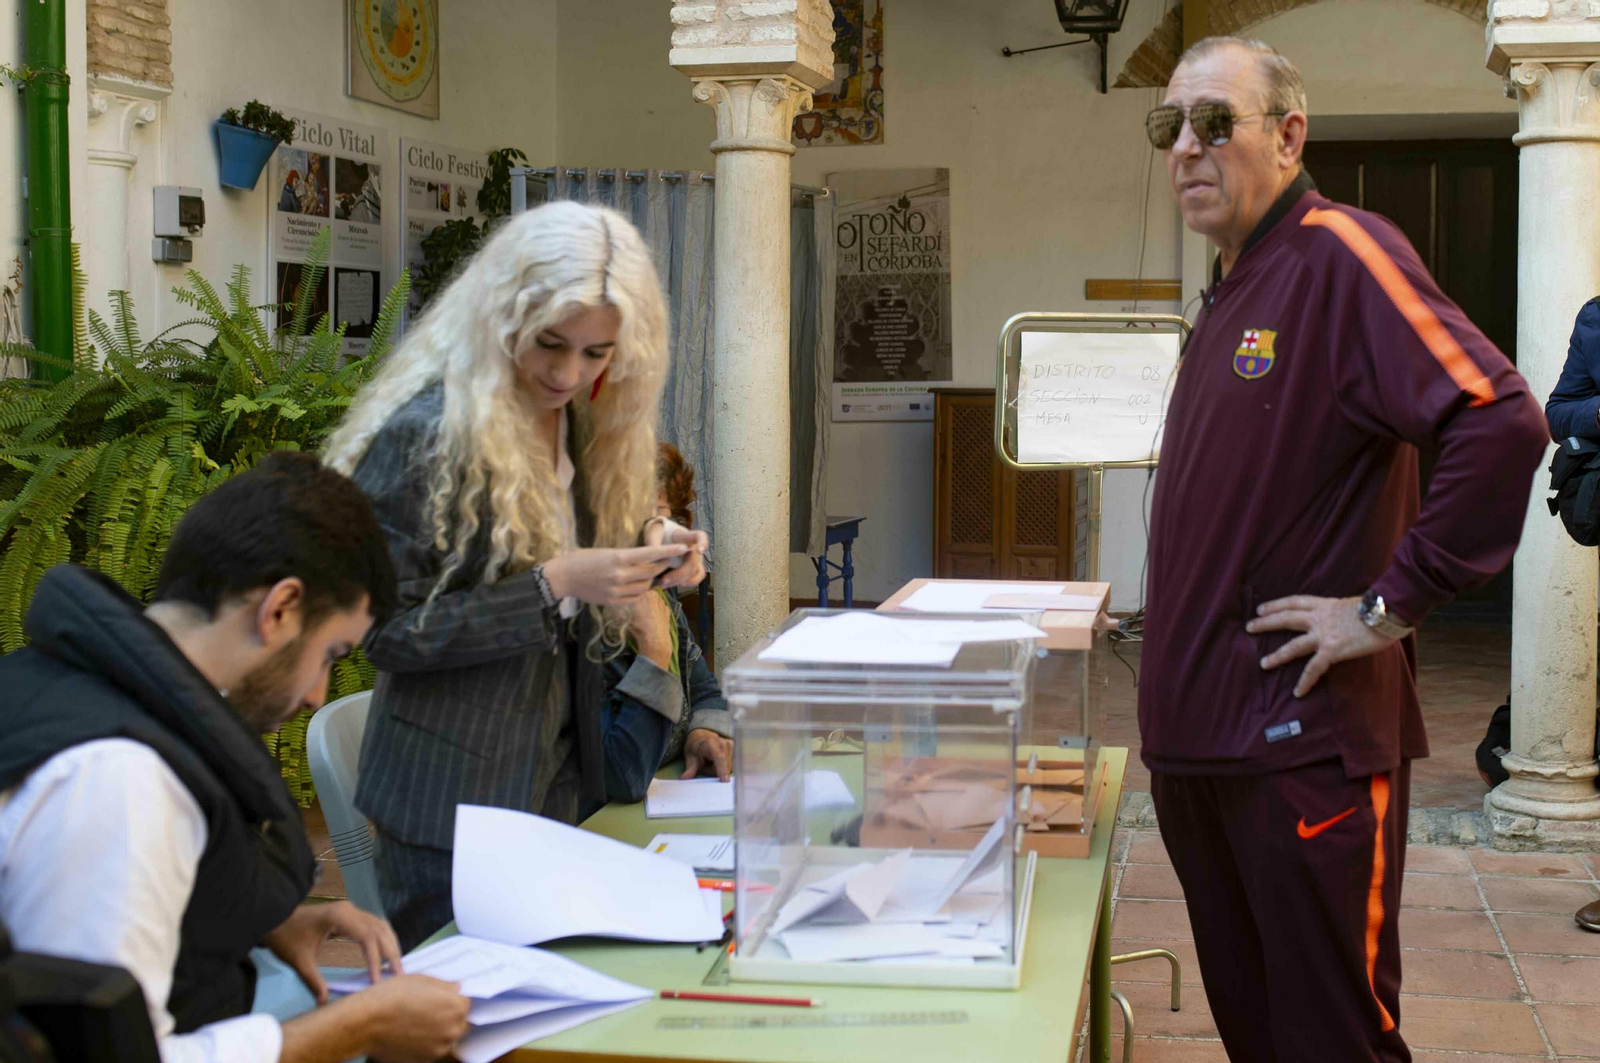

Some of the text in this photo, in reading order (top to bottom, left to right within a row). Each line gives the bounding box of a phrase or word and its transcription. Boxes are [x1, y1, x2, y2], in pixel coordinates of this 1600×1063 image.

[290, 117, 375, 156] Ciclo Vital
[408, 146, 443, 171] Ciclo
[287, 227, 319, 237] Circuncisió
[837, 205, 925, 272] OTOÑO
[867, 231, 941, 256] SEFARDÍ
[844, 253, 858, 262] EN
[867, 251, 943, 272] CÓRDOBA
[1142, 366, 1160, 381] 08
[1128, 394, 1151, 405] 002
[1036, 411, 1070, 425] MESA
